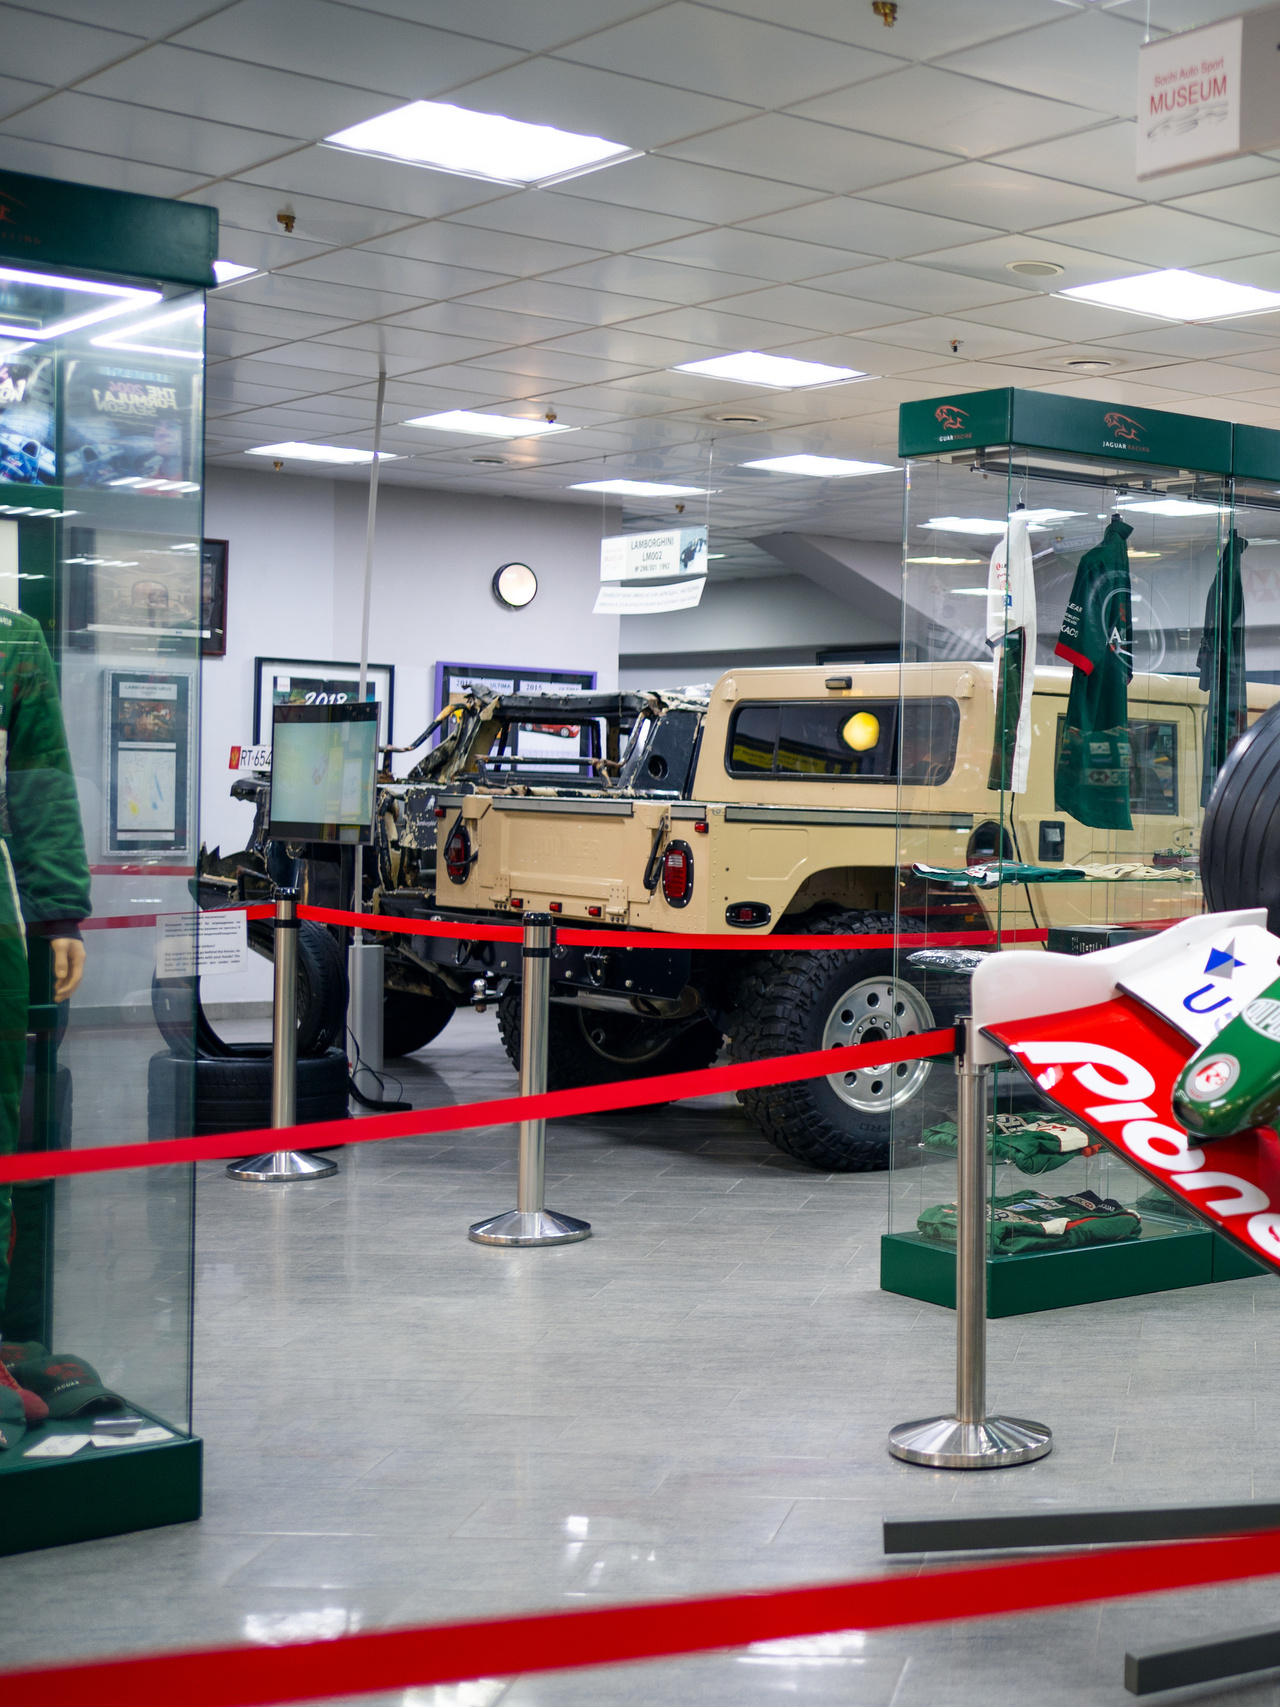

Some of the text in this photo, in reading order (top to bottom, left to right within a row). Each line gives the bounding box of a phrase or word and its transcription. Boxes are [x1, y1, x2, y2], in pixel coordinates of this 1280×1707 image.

[1154, 58, 1224, 88] Sochi Auto Sport
[1150, 75, 1227, 116] MUSEUM
[1102, 441, 1127, 450] JAGUAR
[631, 536, 675, 550] LAMBORGHINI
[642, 551, 662, 561] LM002
[54, 1380, 80, 1393] JAGUAR
